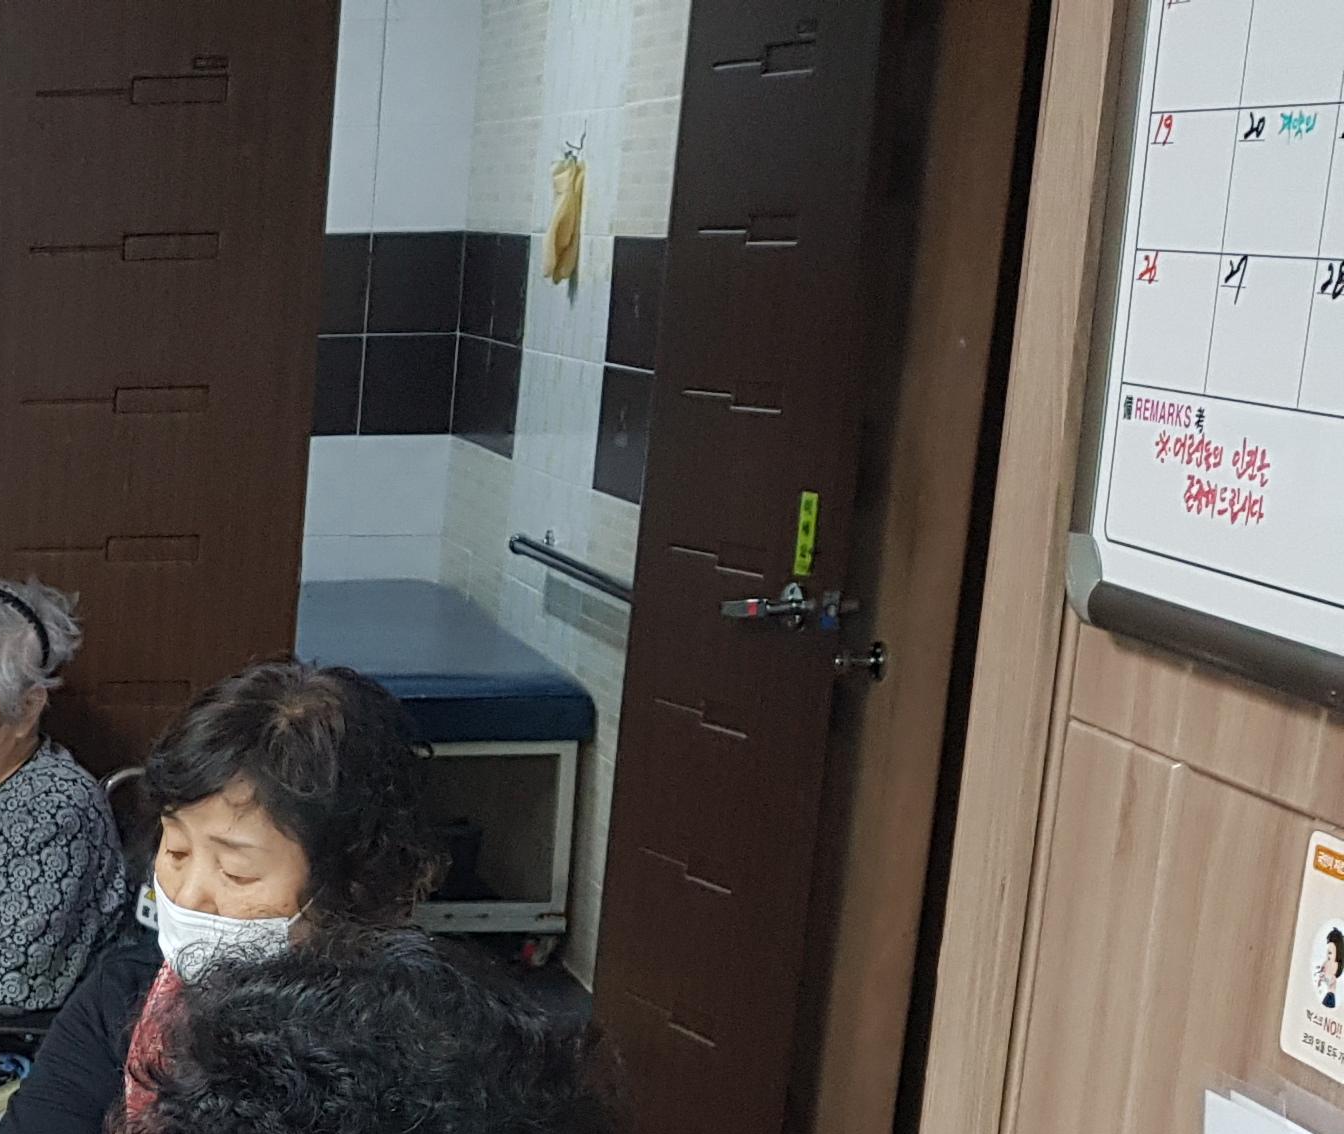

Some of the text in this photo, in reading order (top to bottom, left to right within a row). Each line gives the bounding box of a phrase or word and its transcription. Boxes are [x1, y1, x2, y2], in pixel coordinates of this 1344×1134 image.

[1153, 114, 1173, 146] 19
[1244, 112, 1265, 139] 20
[1134, 397, 1192, 428] REMARKS
